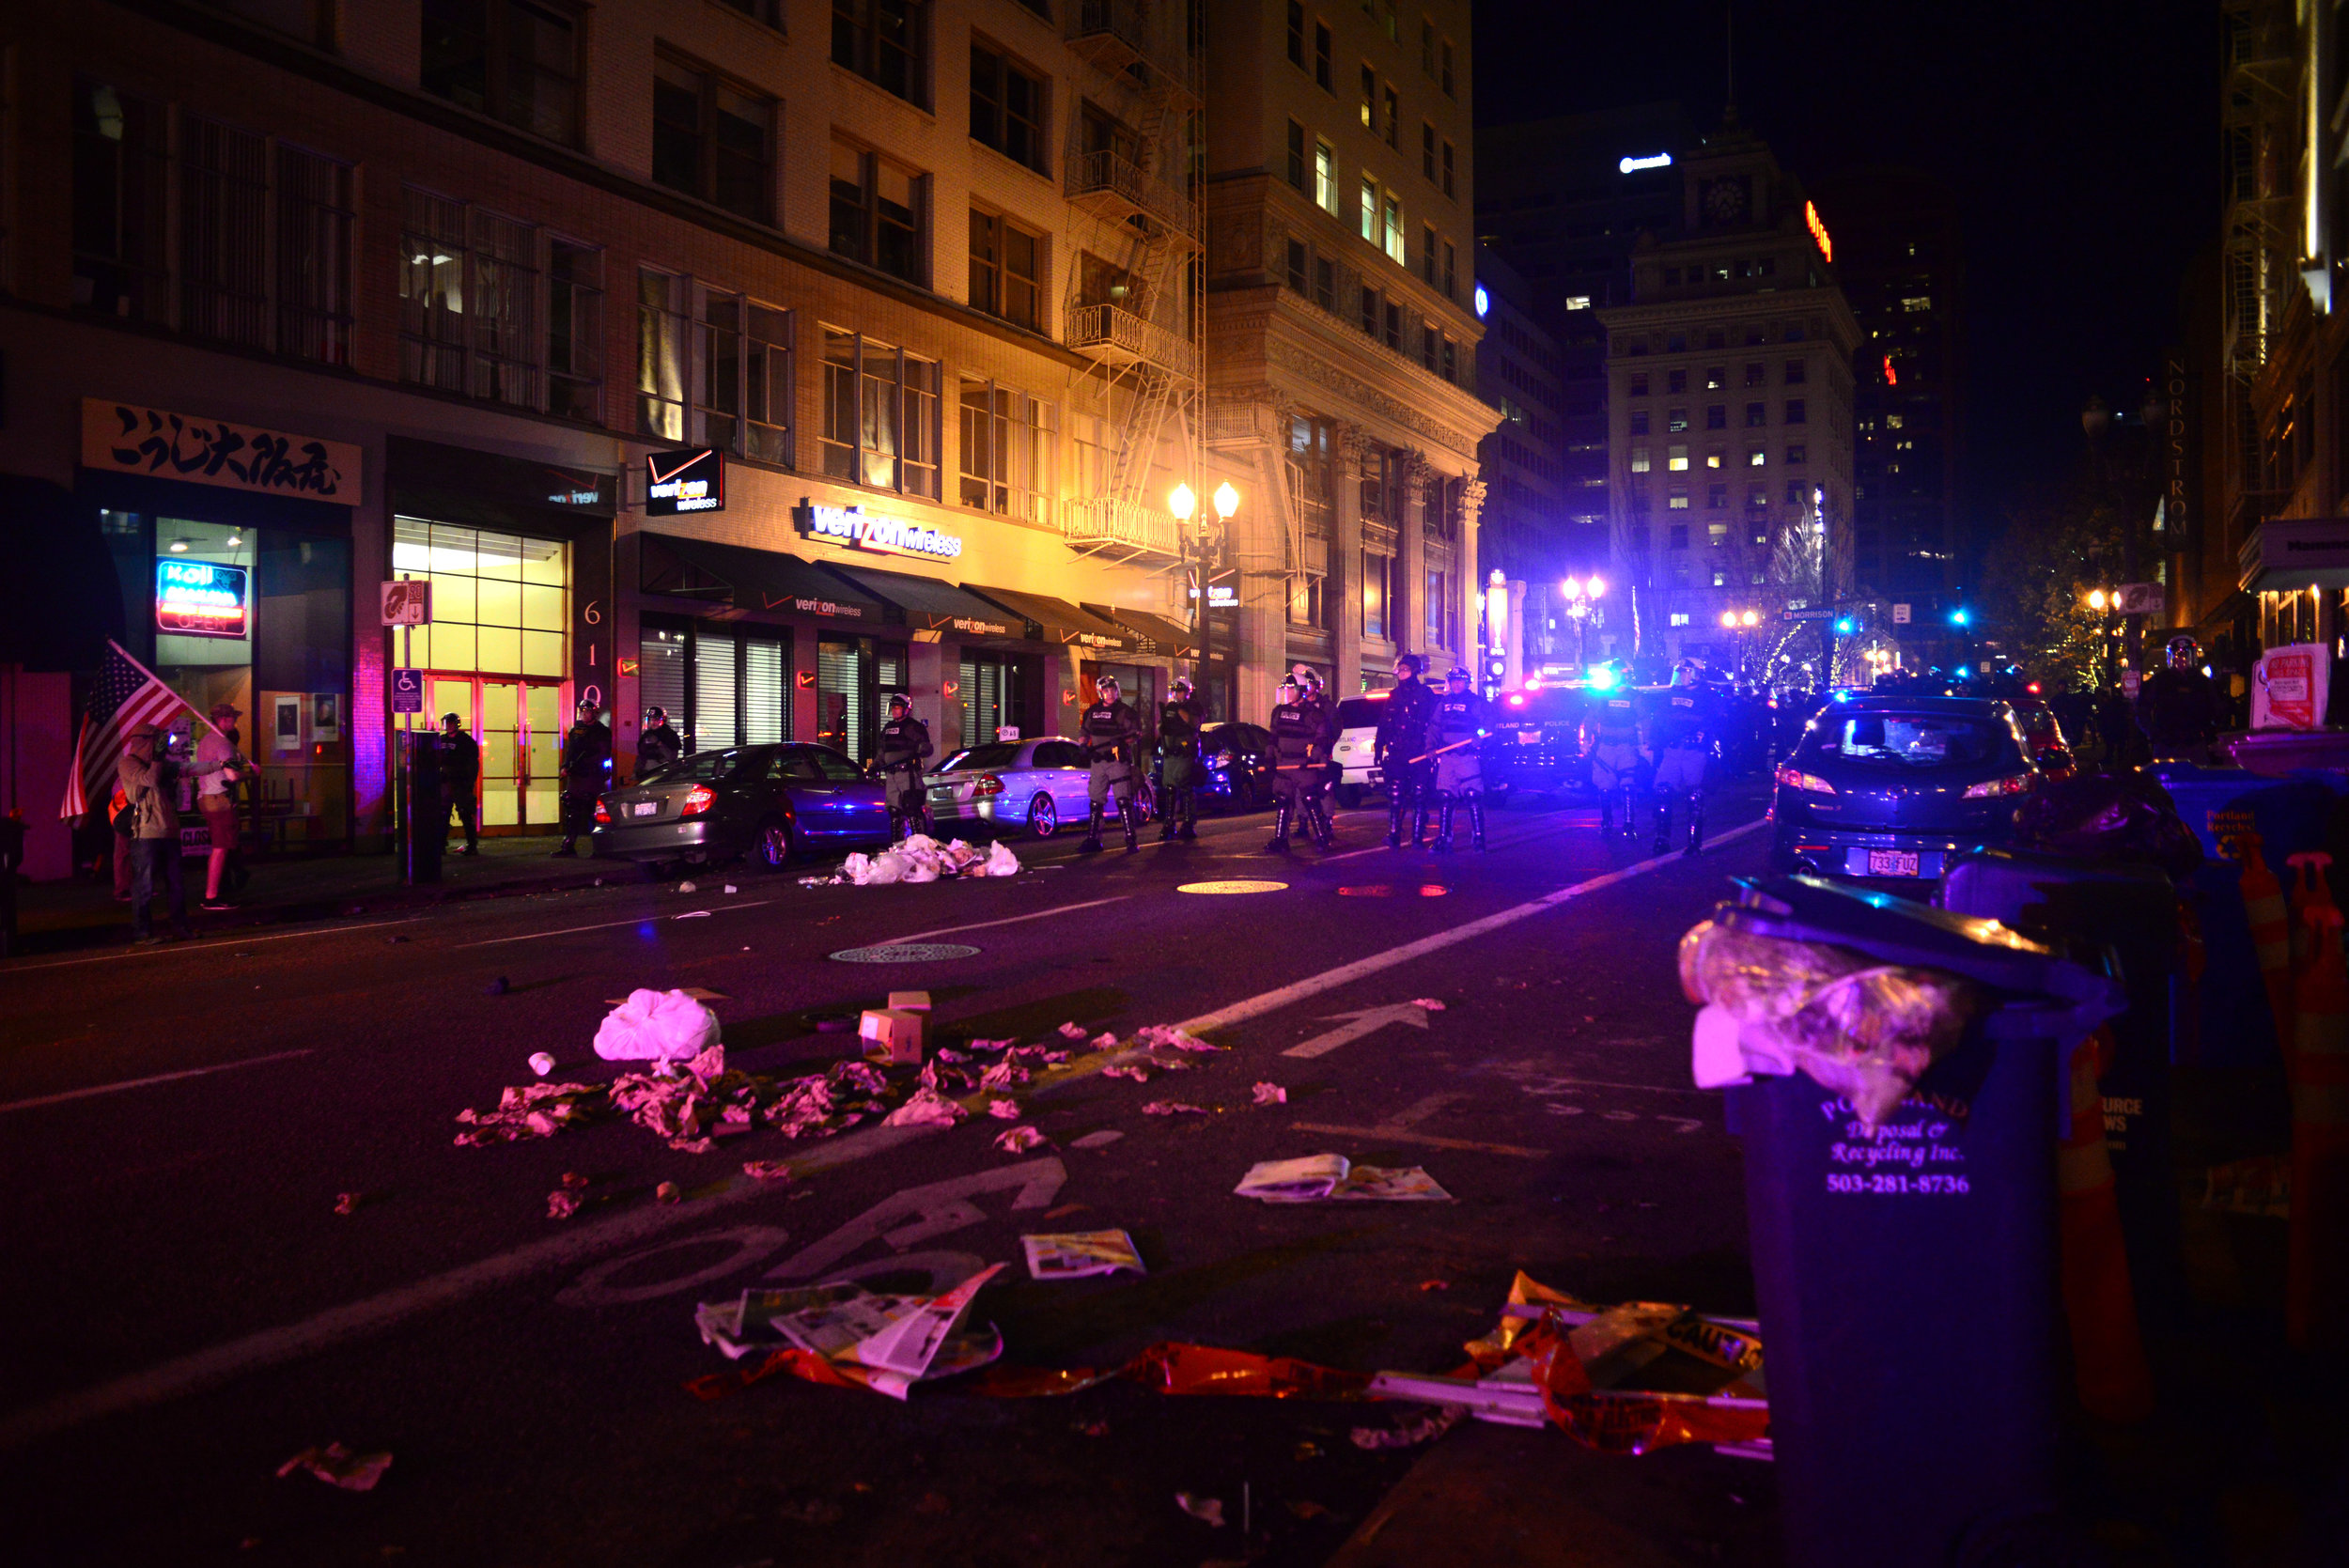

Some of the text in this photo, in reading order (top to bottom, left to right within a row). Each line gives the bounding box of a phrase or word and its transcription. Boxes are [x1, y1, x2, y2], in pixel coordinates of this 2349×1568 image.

[2169, 359, 2186, 536] NORDSTROM
[651, 478, 708, 499] verizon
[677, 497, 717, 510] wireless
[1794, 611, 1833, 619] MORRISON
[2206, 810, 2254, 820] Portland
[183, 831, 211, 846] CLOS
[1871, 856, 1917, 870] 733 FUZ
[1820, 1090, 1969, 1122] POAND
[2103, 1097, 2143, 1115] URCE
[1845, 1119, 1925, 1145] Dposal
[1831, 1141, 1965, 1168] Recycling Inc.
[1826, 1173, 1970, 1194] 503-281-8736
